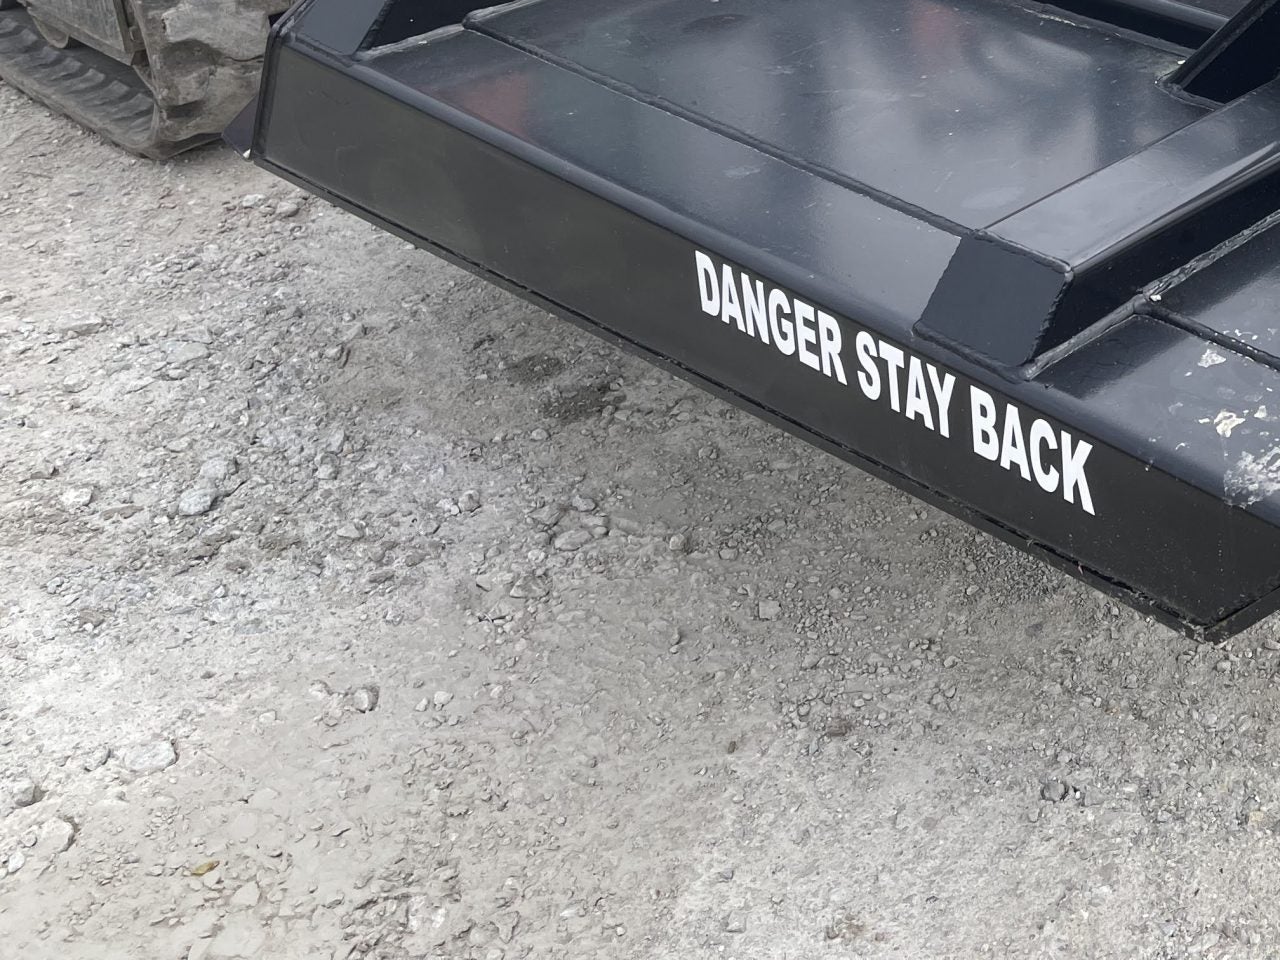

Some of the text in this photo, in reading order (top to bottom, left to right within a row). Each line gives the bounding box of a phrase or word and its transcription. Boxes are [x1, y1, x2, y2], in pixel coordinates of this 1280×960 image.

[694, 249, 1096, 516] DANGER STAY BACK
